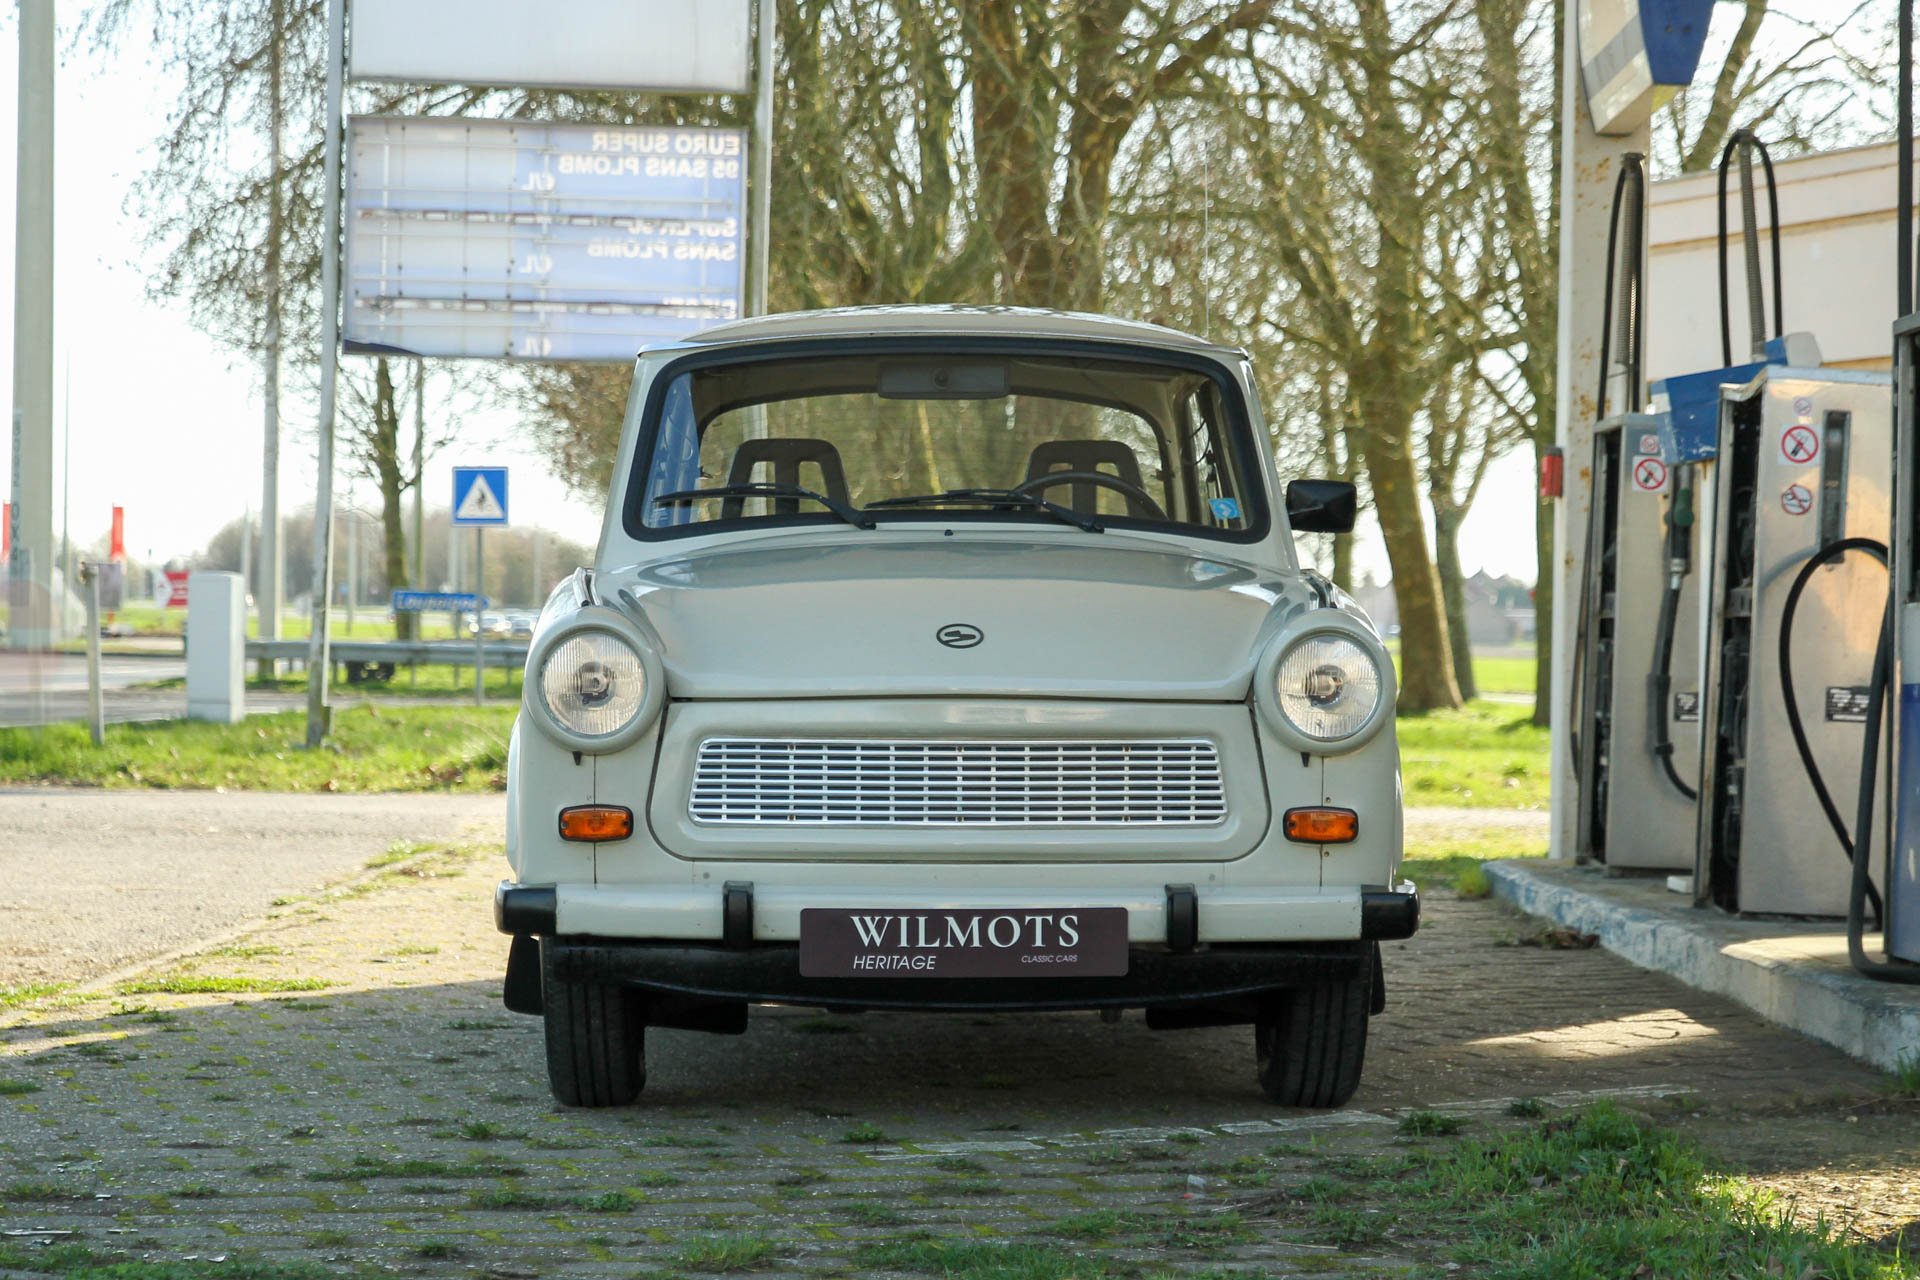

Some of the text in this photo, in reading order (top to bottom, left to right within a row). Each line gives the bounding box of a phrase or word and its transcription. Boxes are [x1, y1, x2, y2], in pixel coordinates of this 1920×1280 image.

[850, 915, 1079, 948] WILMOTS
[853, 955, 937, 970] HERITAGE
[1021, 954, 1078, 963] CLASSIC CARS
